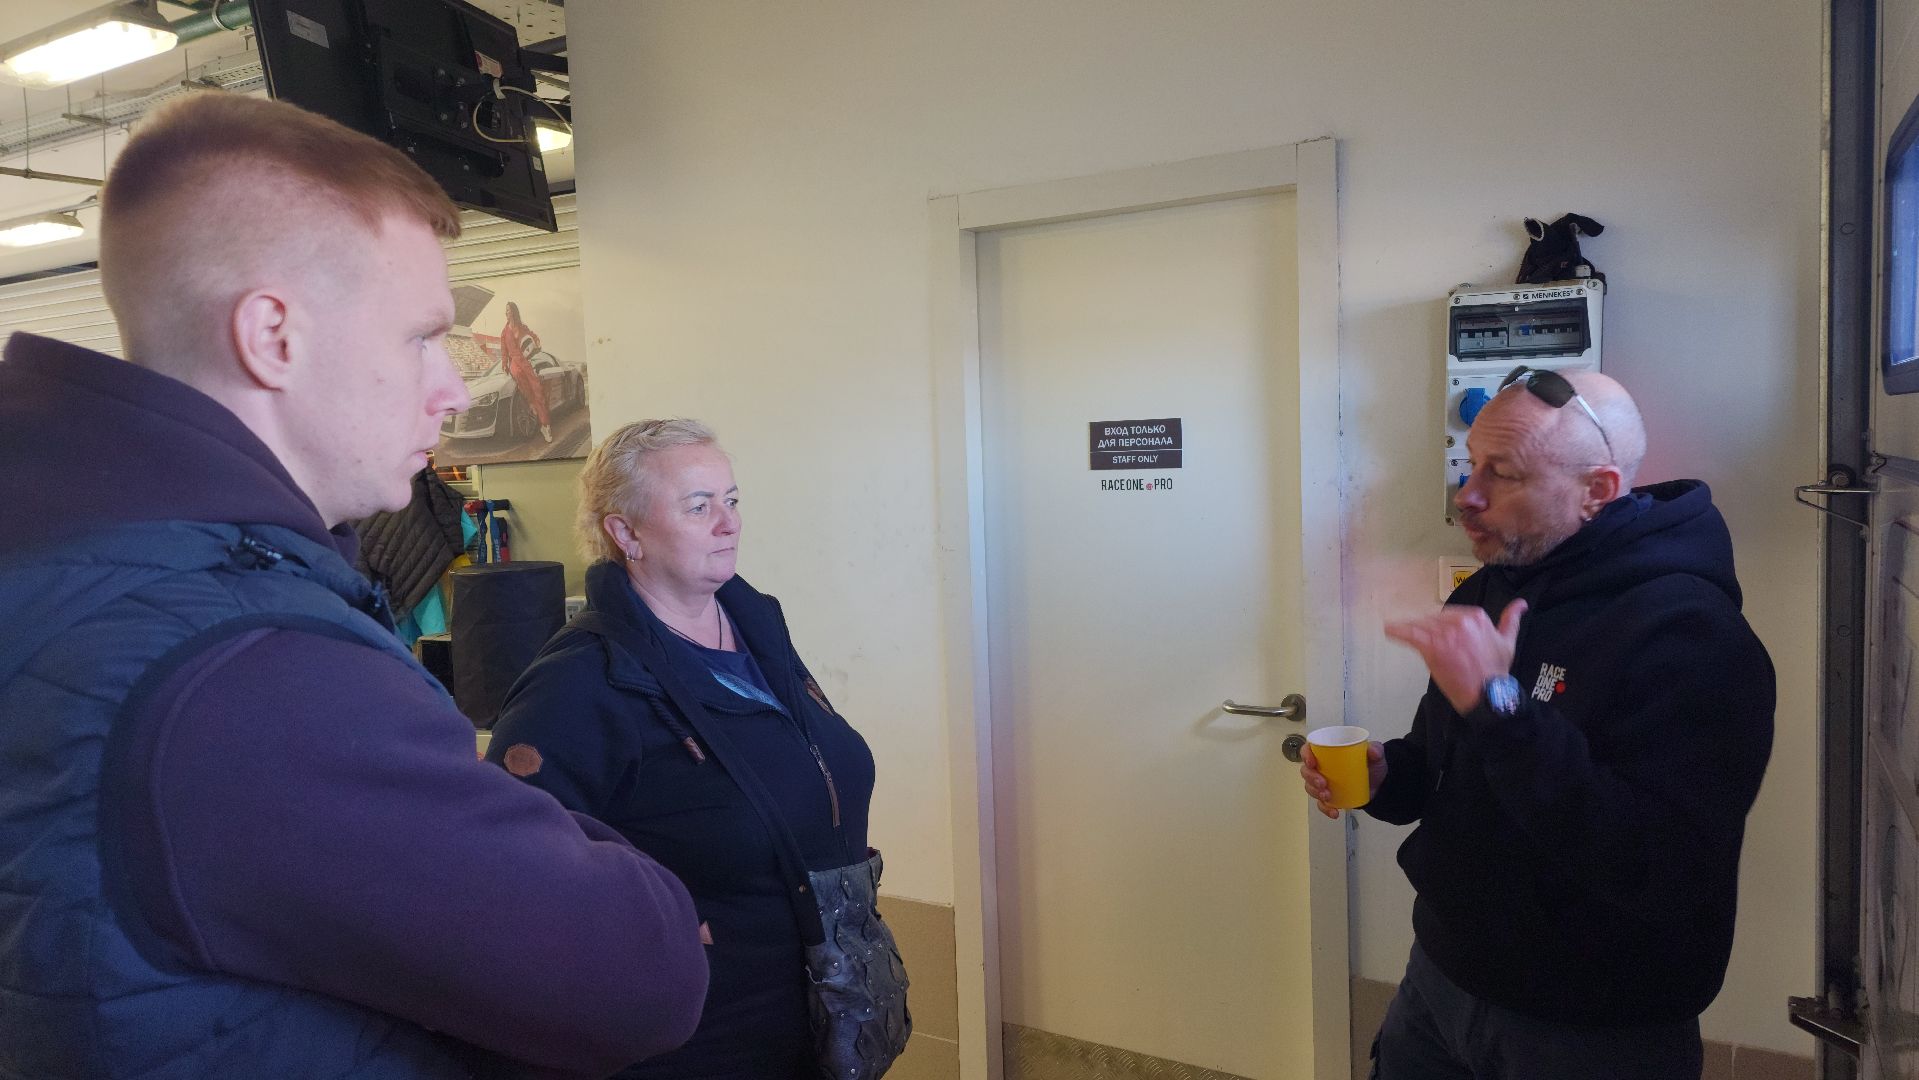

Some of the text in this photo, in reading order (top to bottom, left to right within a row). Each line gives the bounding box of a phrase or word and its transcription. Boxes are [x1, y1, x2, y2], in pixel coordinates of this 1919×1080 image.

[1104, 424, 1166, 436] ВХОД ТОЛЬКО
[1097, 436, 1173, 448] ДЛЯ ПЕРСОНАЛА
[1112, 454, 1159, 464] STAFF ONLY
[1539, 662, 1566, 681] RACE
[1535, 675, 1558, 692] ONE
[1531, 686, 1552, 702] PRO
